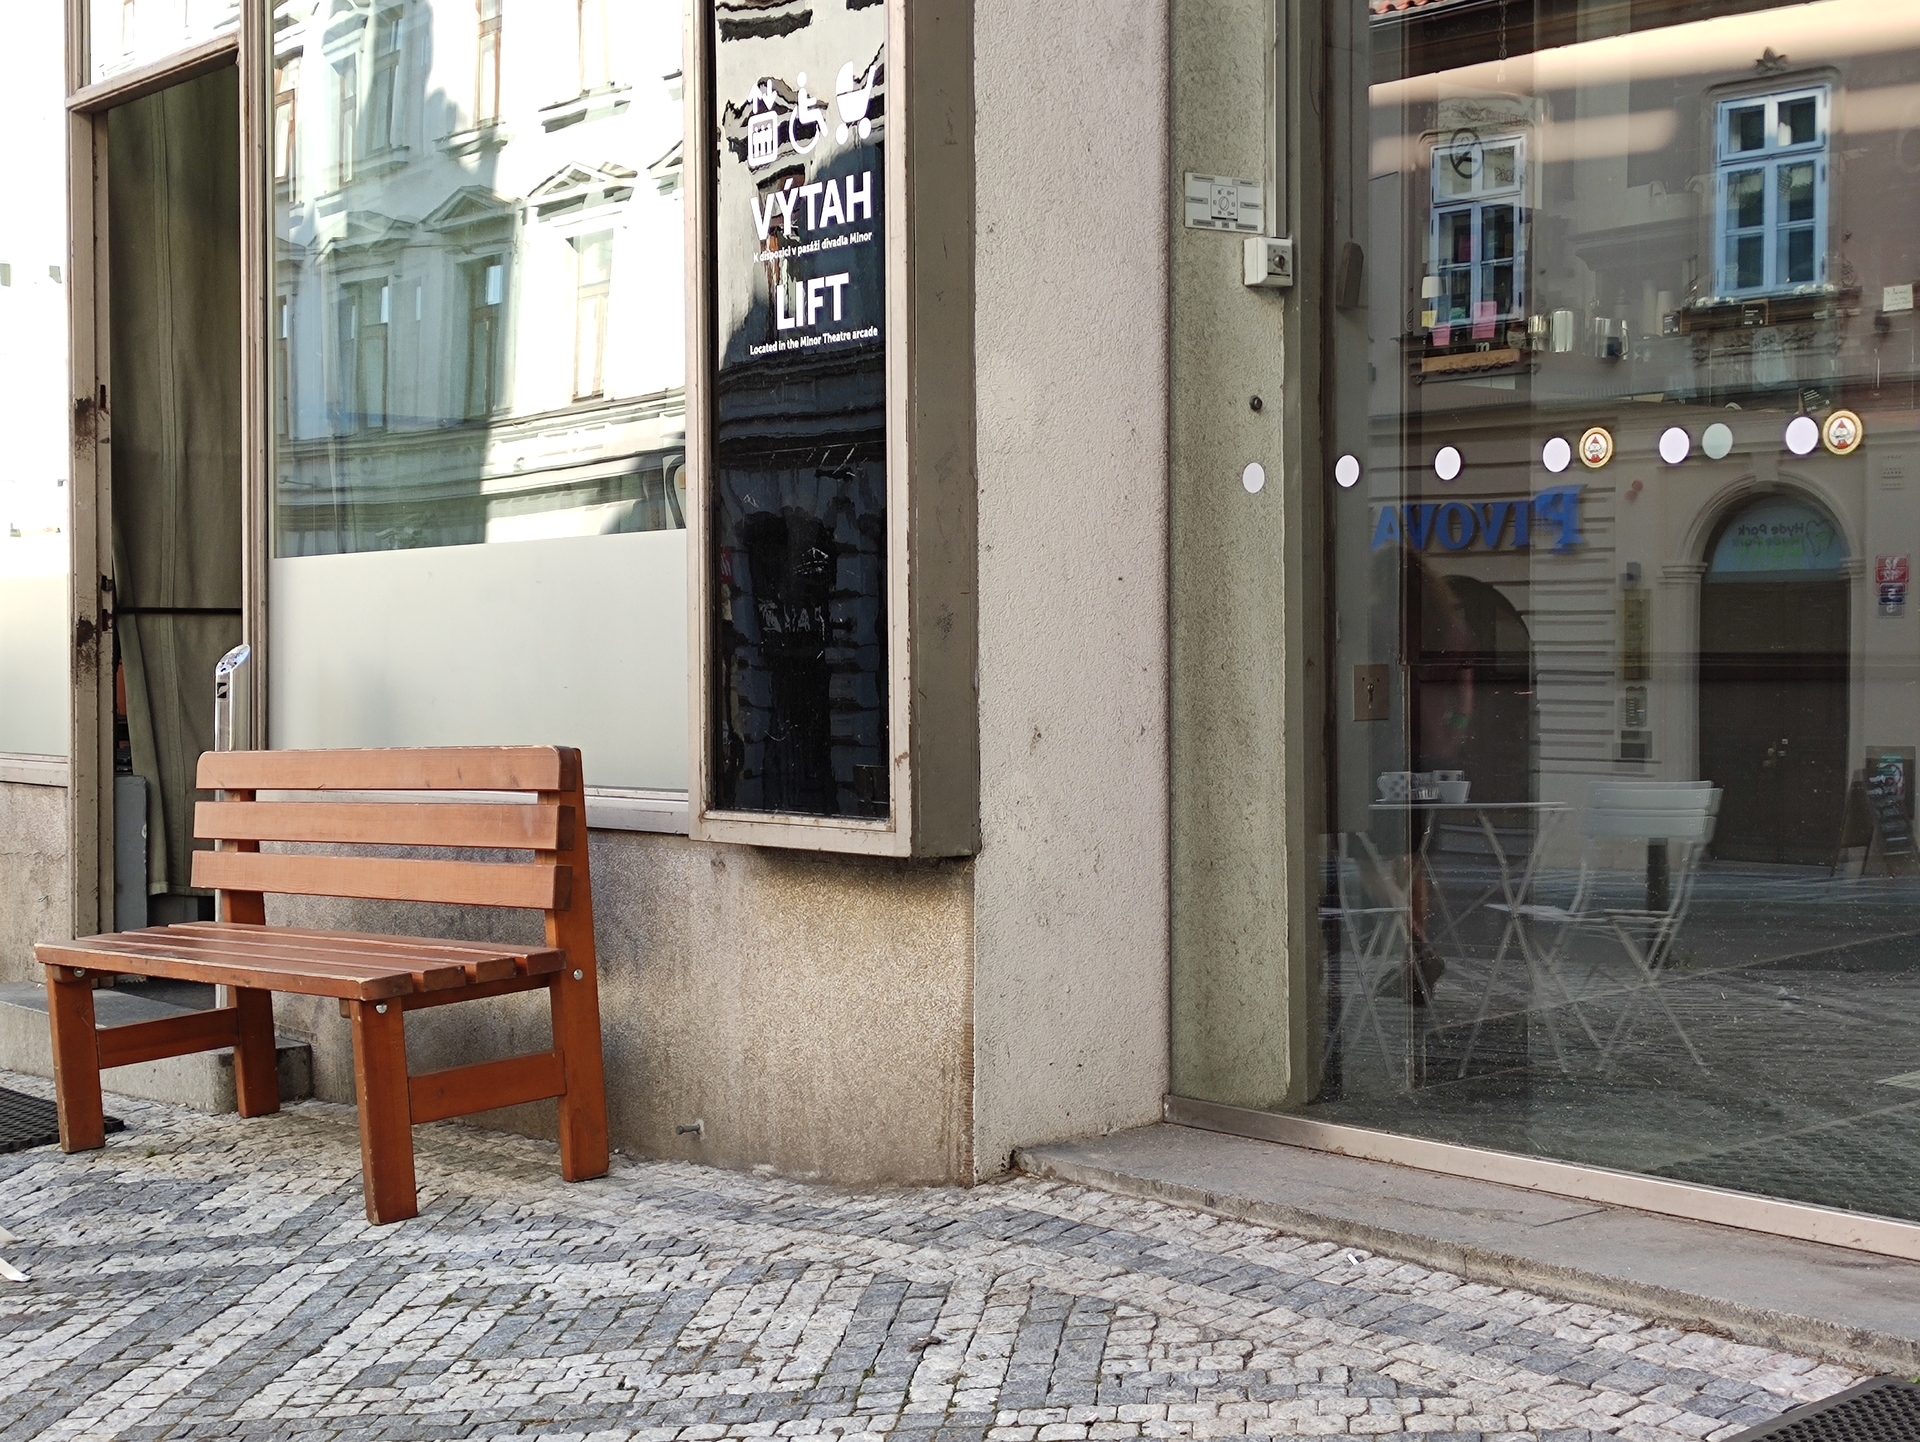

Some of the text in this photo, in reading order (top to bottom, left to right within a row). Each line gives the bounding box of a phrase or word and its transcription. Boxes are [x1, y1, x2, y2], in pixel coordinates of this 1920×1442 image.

[750, 171, 872, 241] VÝTAH
[753, 232, 873, 263] K dispozici v pasáži divadla Minor
[777, 272, 849, 330] LIFT
[749, 325, 878, 355] Located in the Minor Theatre arcade
